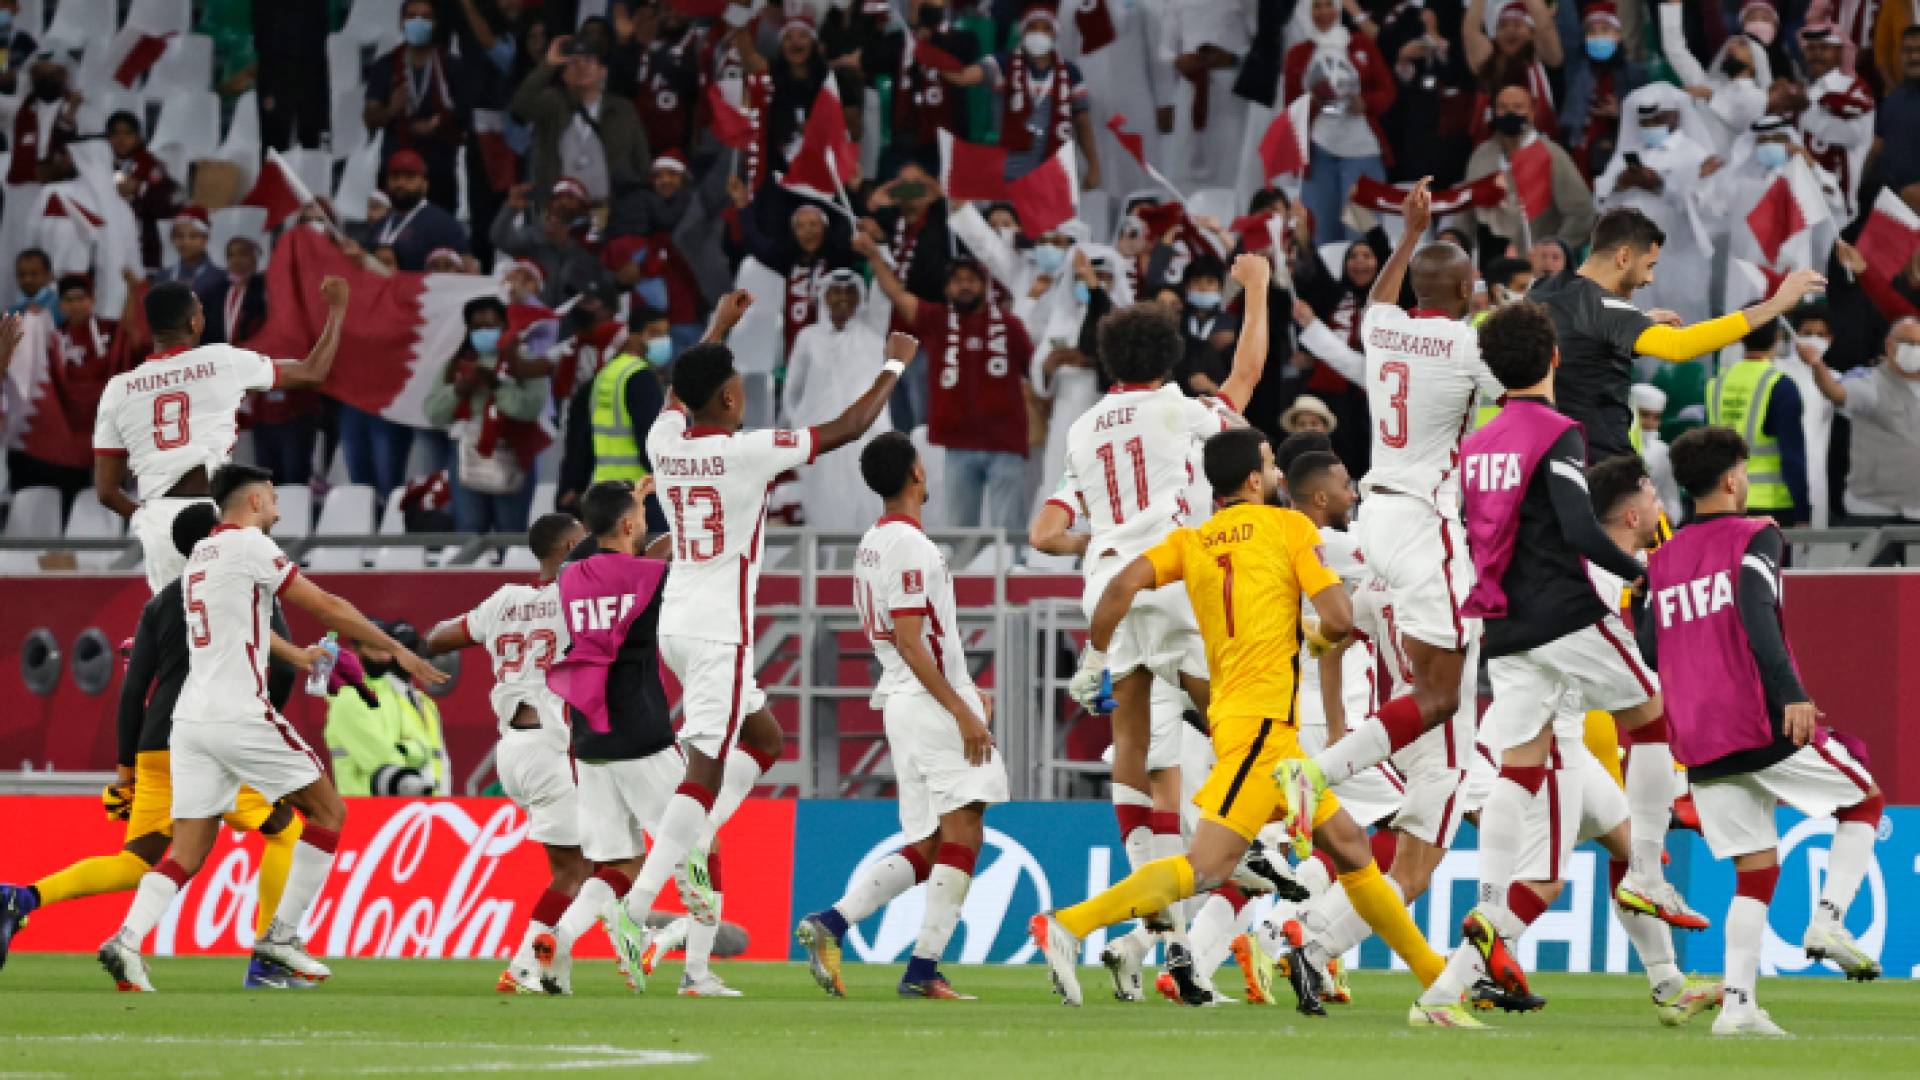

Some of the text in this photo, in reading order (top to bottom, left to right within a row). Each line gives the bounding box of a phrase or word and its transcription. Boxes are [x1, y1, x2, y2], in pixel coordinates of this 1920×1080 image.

[126, 361, 217, 395] MUNTARI
[1379, 361, 1410, 449] 3
[152, 390, 191, 451] 9
[1095, 434, 1150, 525] 11
[1465, 452, 1522, 493] FIFA
[666, 485, 725, 562] 13
[188, 570, 211, 648] 5
[1215, 551, 1235, 639] 1
[1657, 570, 1735, 629] FIFA
